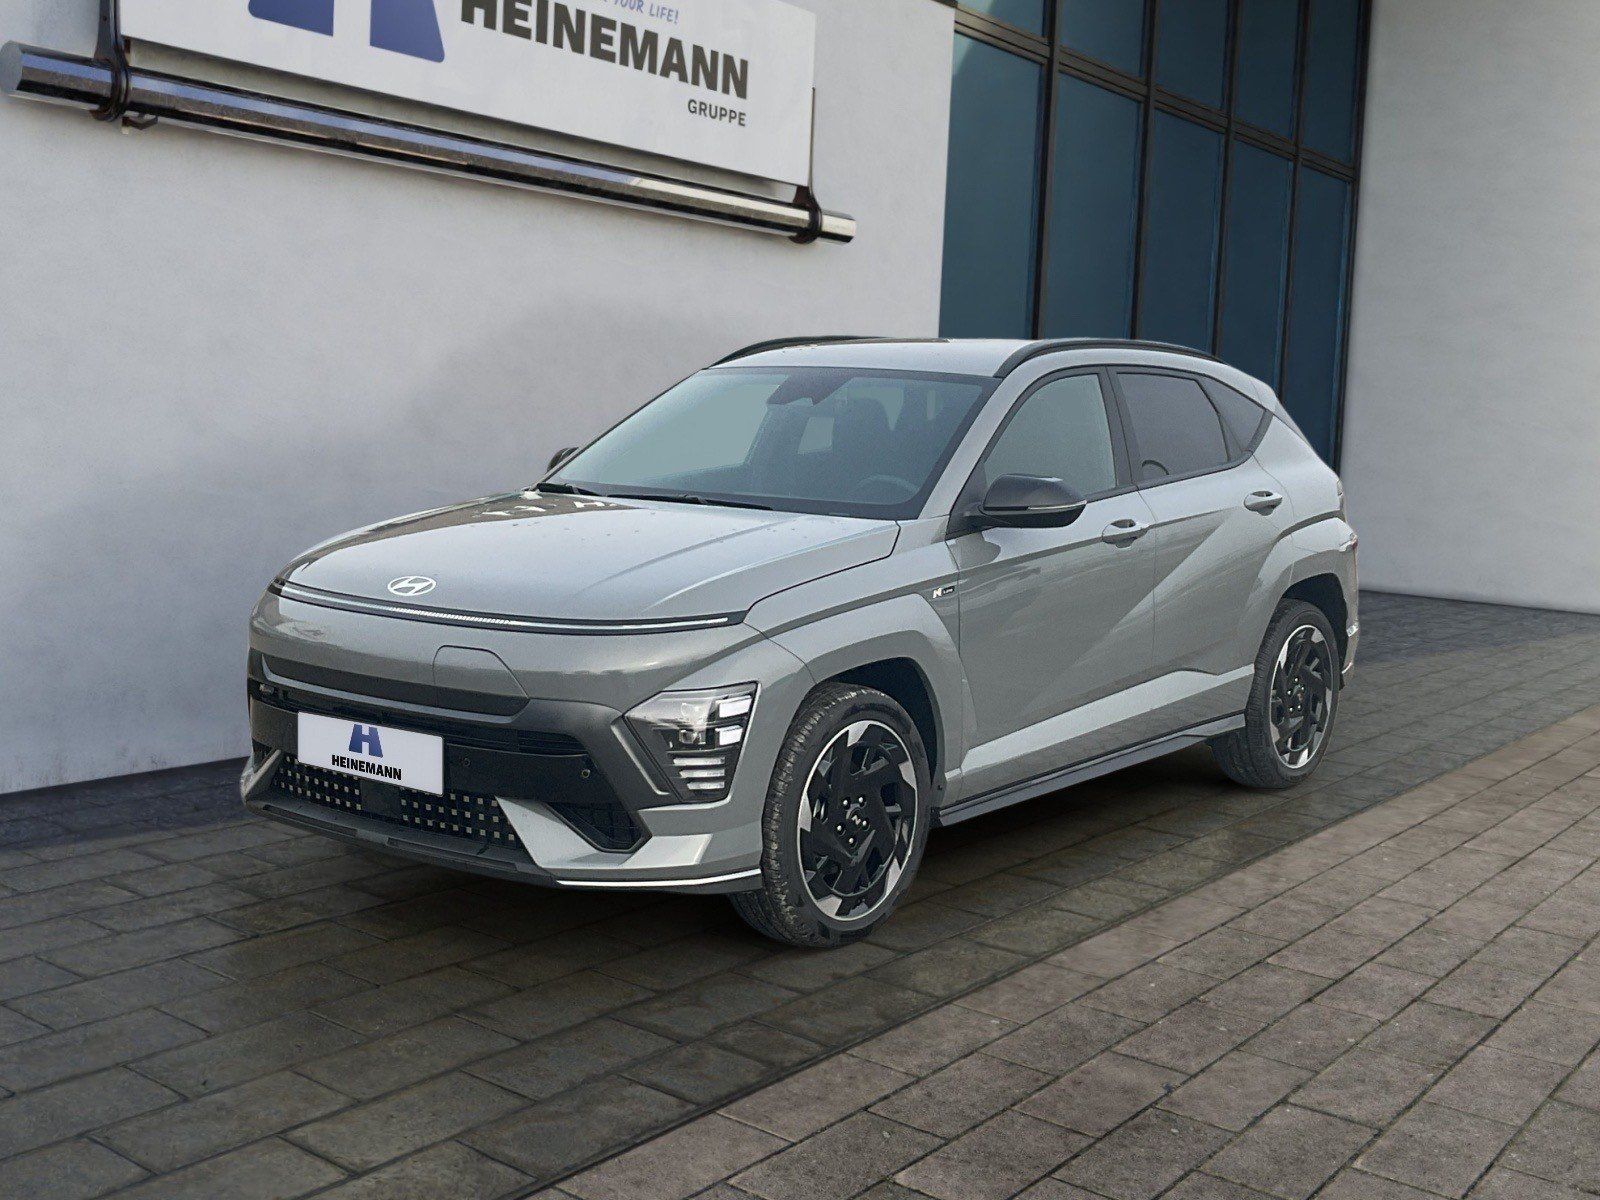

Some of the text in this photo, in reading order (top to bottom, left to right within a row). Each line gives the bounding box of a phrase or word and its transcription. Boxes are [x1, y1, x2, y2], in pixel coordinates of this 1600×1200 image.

[649, 4, 679, 24] LIFE!
[687, 99, 746, 127] GRUPPE
[331, 754, 402, 780] HEINEMANN
